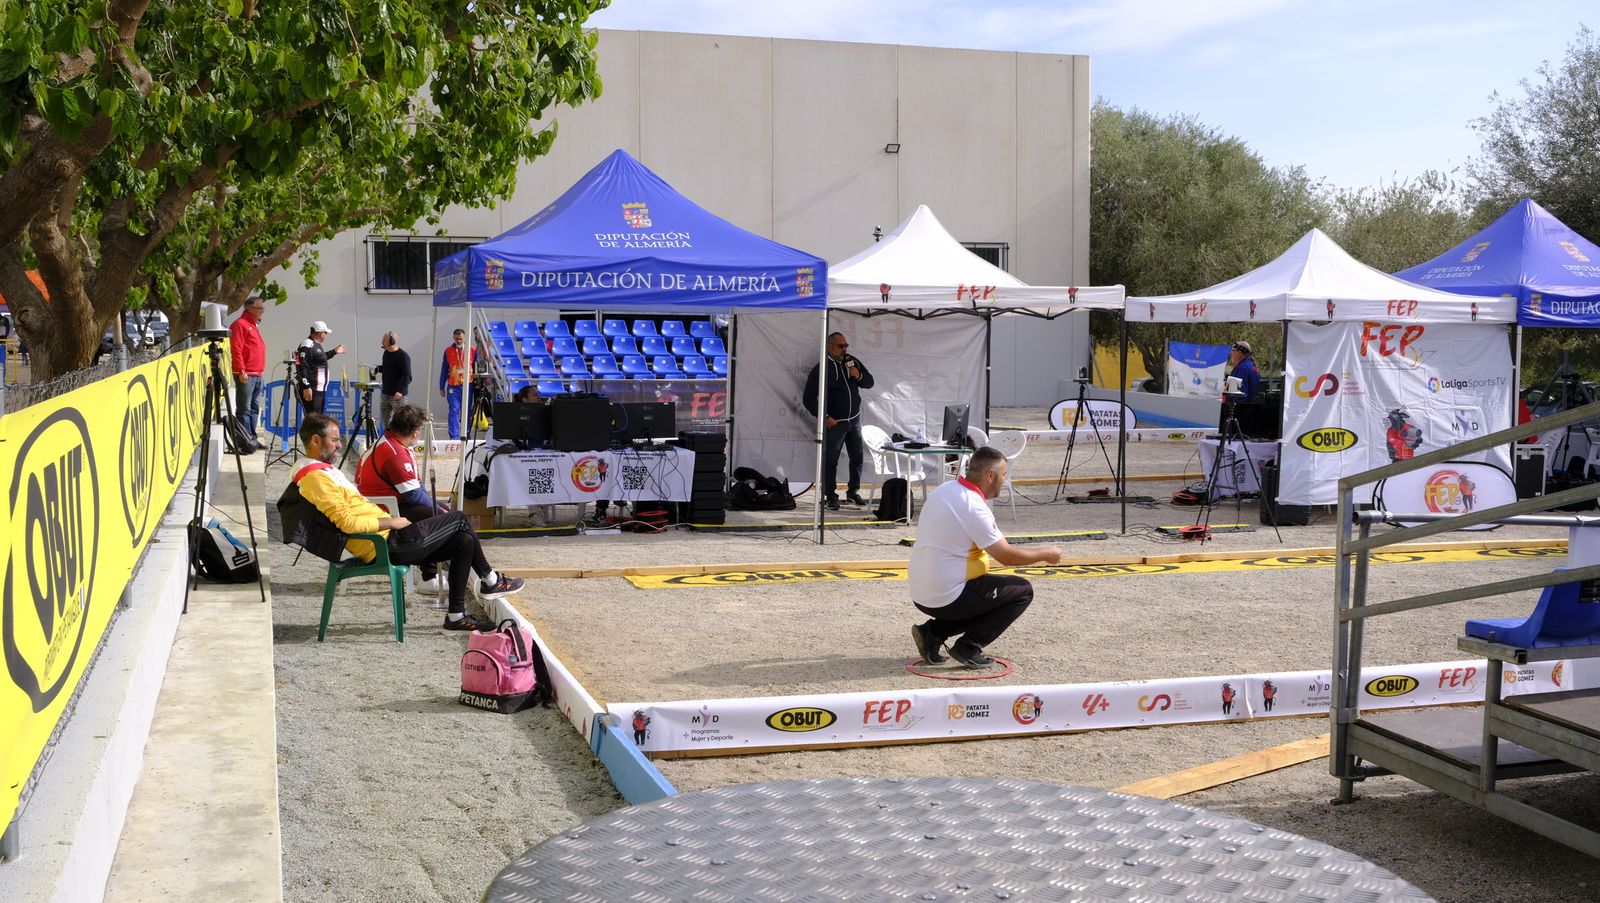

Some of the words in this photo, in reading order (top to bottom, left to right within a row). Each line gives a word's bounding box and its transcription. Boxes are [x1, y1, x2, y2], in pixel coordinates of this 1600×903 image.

[594, 231, 690, 240] DIPUTACIÓN
[521, 268, 652, 288] DIPUTACIÓN
[662, 273, 686, 289] DE
[693, 272, 780, 292] ALMERÍA
[1186, 302, 1207, 318] FEP
[1388, 300, 1418, 316] FEP
[1360, 322, 1424, 357] FEP
[1312, 432, 1346, 446] OBUT
[130, 400, 148, 511] OBUT
[26, 443, 84, 645] OBUT
[713, 570, 849, 582] OBUT
[1376, 679, 1408, 692] OBUT
[1439, 667, 1476, 688] FEP
[460, 692, 498, 710] PETANCA
[780, 711, 822, 726] OBUT
[863, 700, 912, 724] FEP
